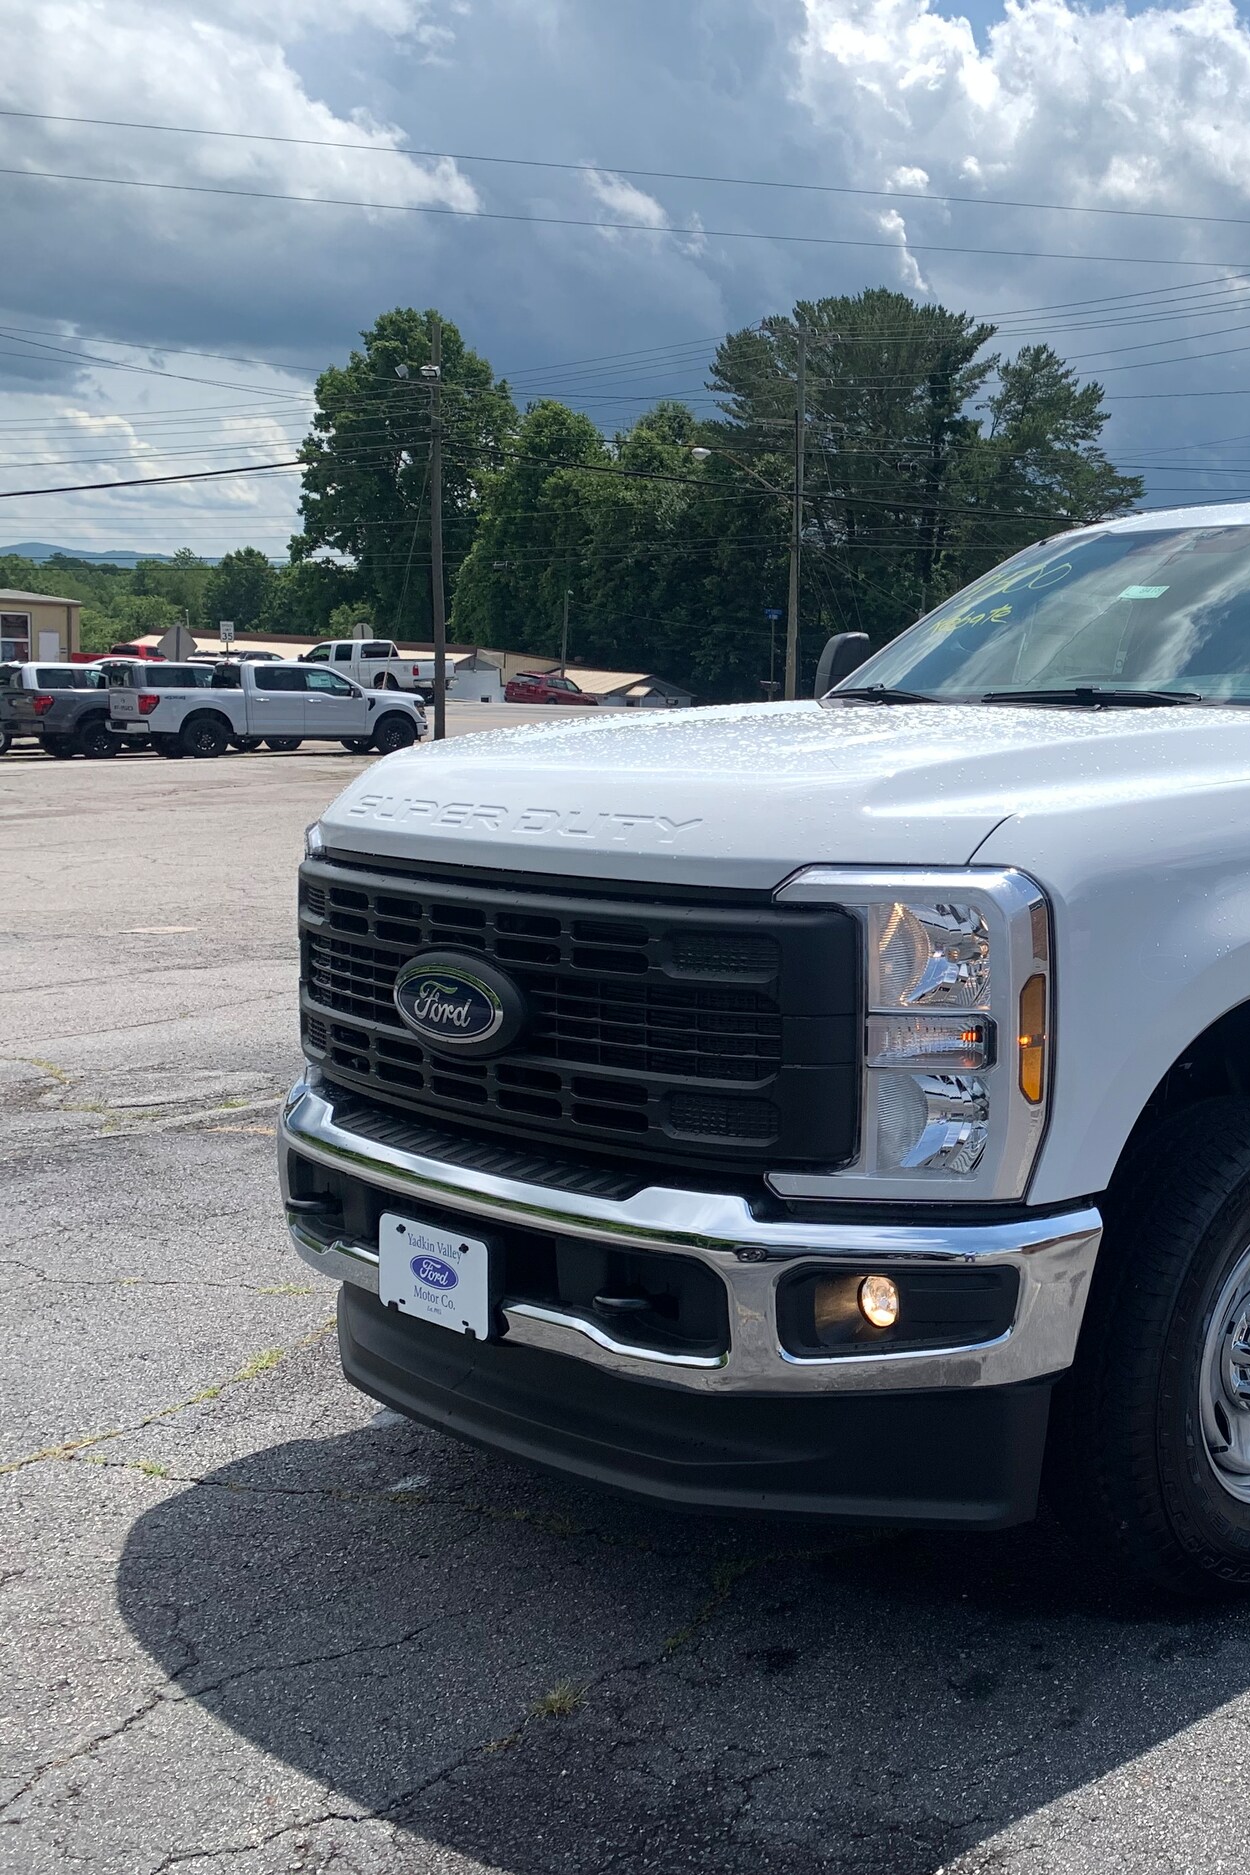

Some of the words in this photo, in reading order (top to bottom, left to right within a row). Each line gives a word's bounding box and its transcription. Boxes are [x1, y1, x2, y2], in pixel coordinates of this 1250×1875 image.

[222, 632, 233, 640] 35
[347, 794, 508, 832] SUPER
[512, 807, 703, 845] DUTY
[414, 980, 472, 1028] Ford
[407, 1232, 435, 1253] Yadkin
[436, 1241, 462, 1265] Valley
[419, 1259, 449, 1286] Ford
[413, 1285, 439, 1305] Motor
[441, 1294, 456, 1311] Co.
